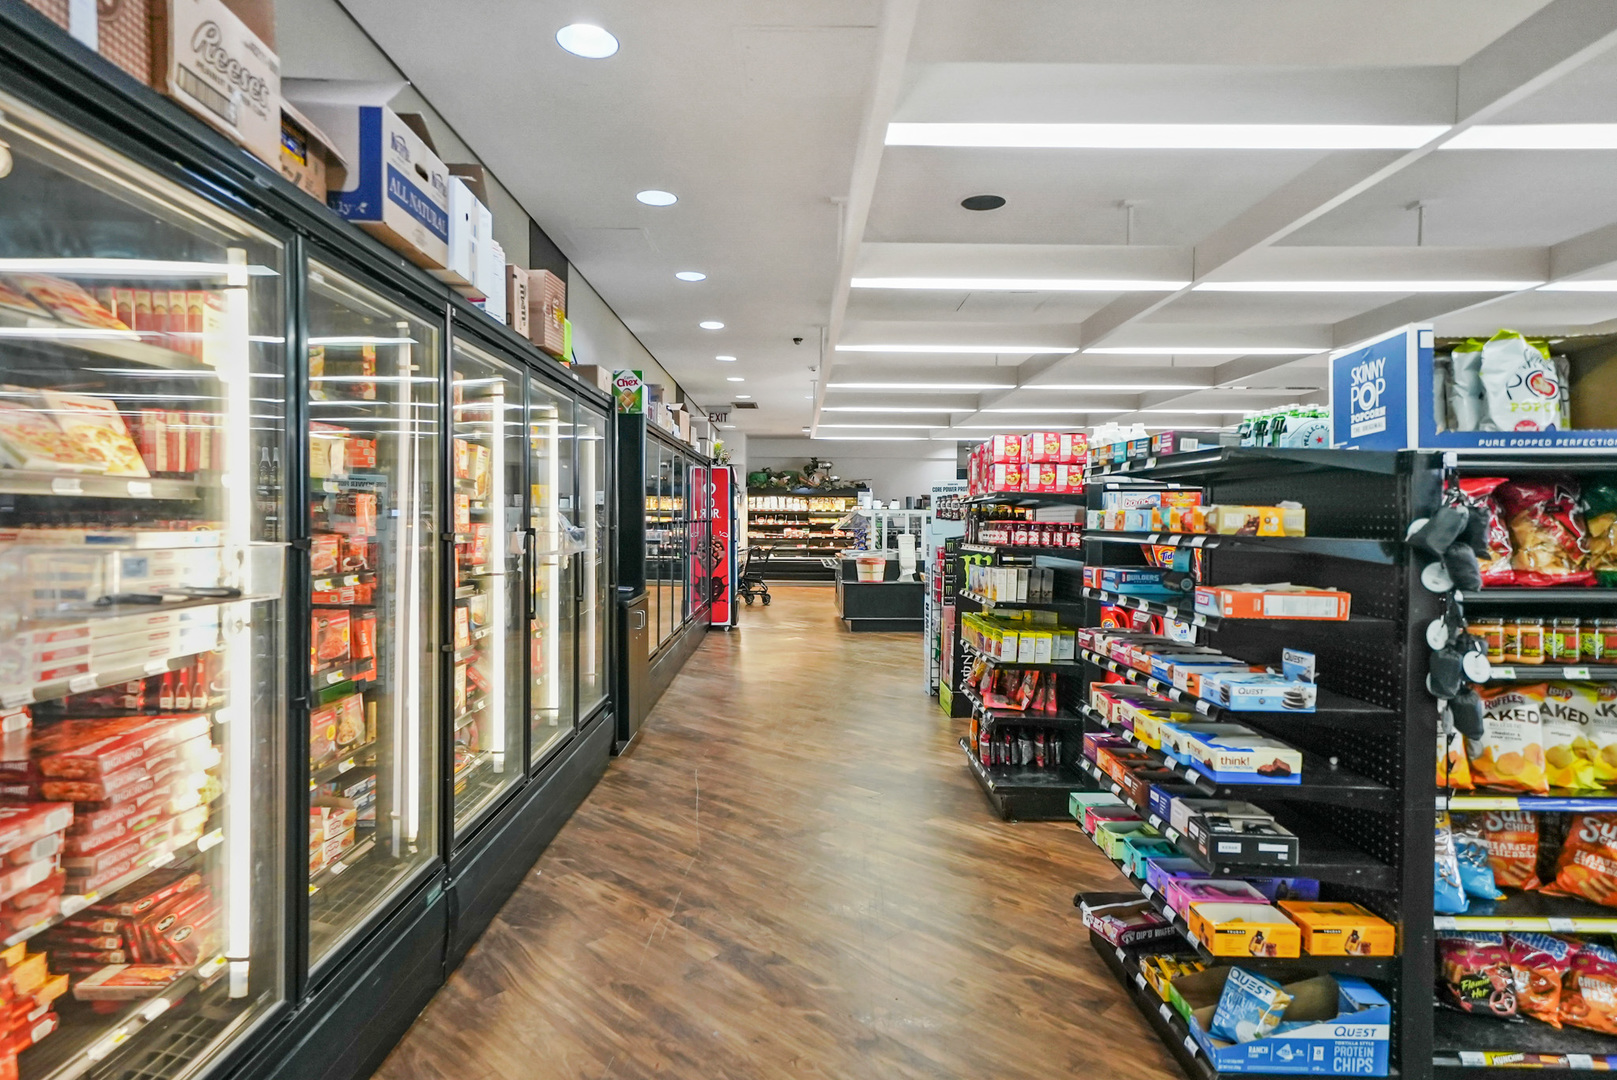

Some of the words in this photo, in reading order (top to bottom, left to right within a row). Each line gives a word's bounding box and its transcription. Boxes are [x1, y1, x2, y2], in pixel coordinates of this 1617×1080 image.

[190, 20, 271, 111] Reese's
[389, 177, 409, 204] ALL
[410, 191, 448, 236] NATURAL
[1351, 357, 1386, 387] SKINNY
[617, 378, 639, 388] Chex
[1351, 378, 1386, 414] POP
[709, 412, 728, 423] EXIT
[1351, 406, 1386, 424] POPCORN
[1478, 439, 1506, 447] PURE
[1510, 439, 1552, 447] POPPED
[1125, 498, 1155, 507] bounce
[1126, 574, 1159, 582] BUILDERS
[1237, 687, 1265, 695] QUEST
[1484, 693, 1526, 710] RUFFLES
[1220, 756, 1250, 766] think!
[1504, 822, 1536, 833] CHIPS
[1579, 816, 1617, 843] Su
[1230, 968, 1272, 996] QUEST
[1471, 987, 1489, 998] Hot
[1334, 1025, 1377, 1037] QUEST
[1248, 1046, 1269, 1054] RANCH
[1334, 1046, 1375, 1057] PROTEIN
[1333, 1057, 1374, 1073] CHIPS
